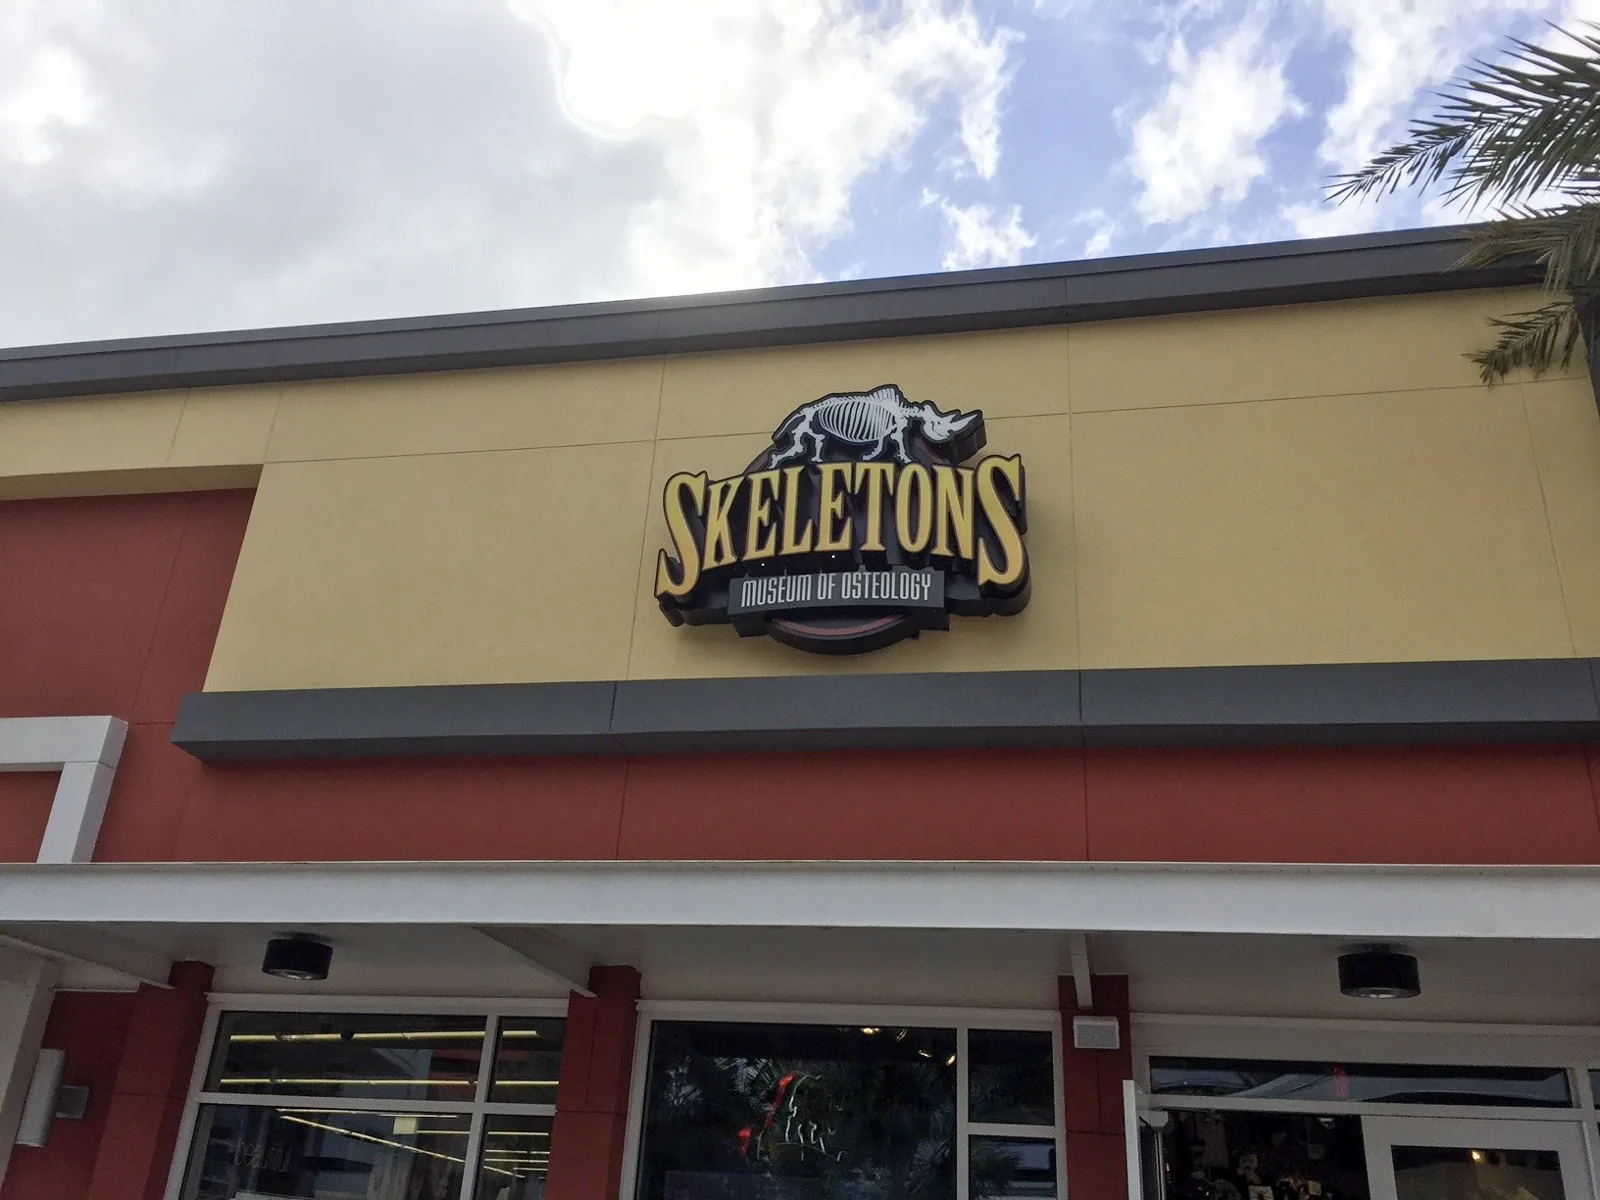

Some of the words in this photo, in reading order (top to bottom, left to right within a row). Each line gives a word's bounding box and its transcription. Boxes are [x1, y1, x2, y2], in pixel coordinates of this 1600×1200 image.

[655, 454, 1025, 598] SKELETONS
[741, 574, 812, 608] MUSEUM
[817, 572, 837, 600] OF
[841, 571, 932, 601] OSTEOLOGY
